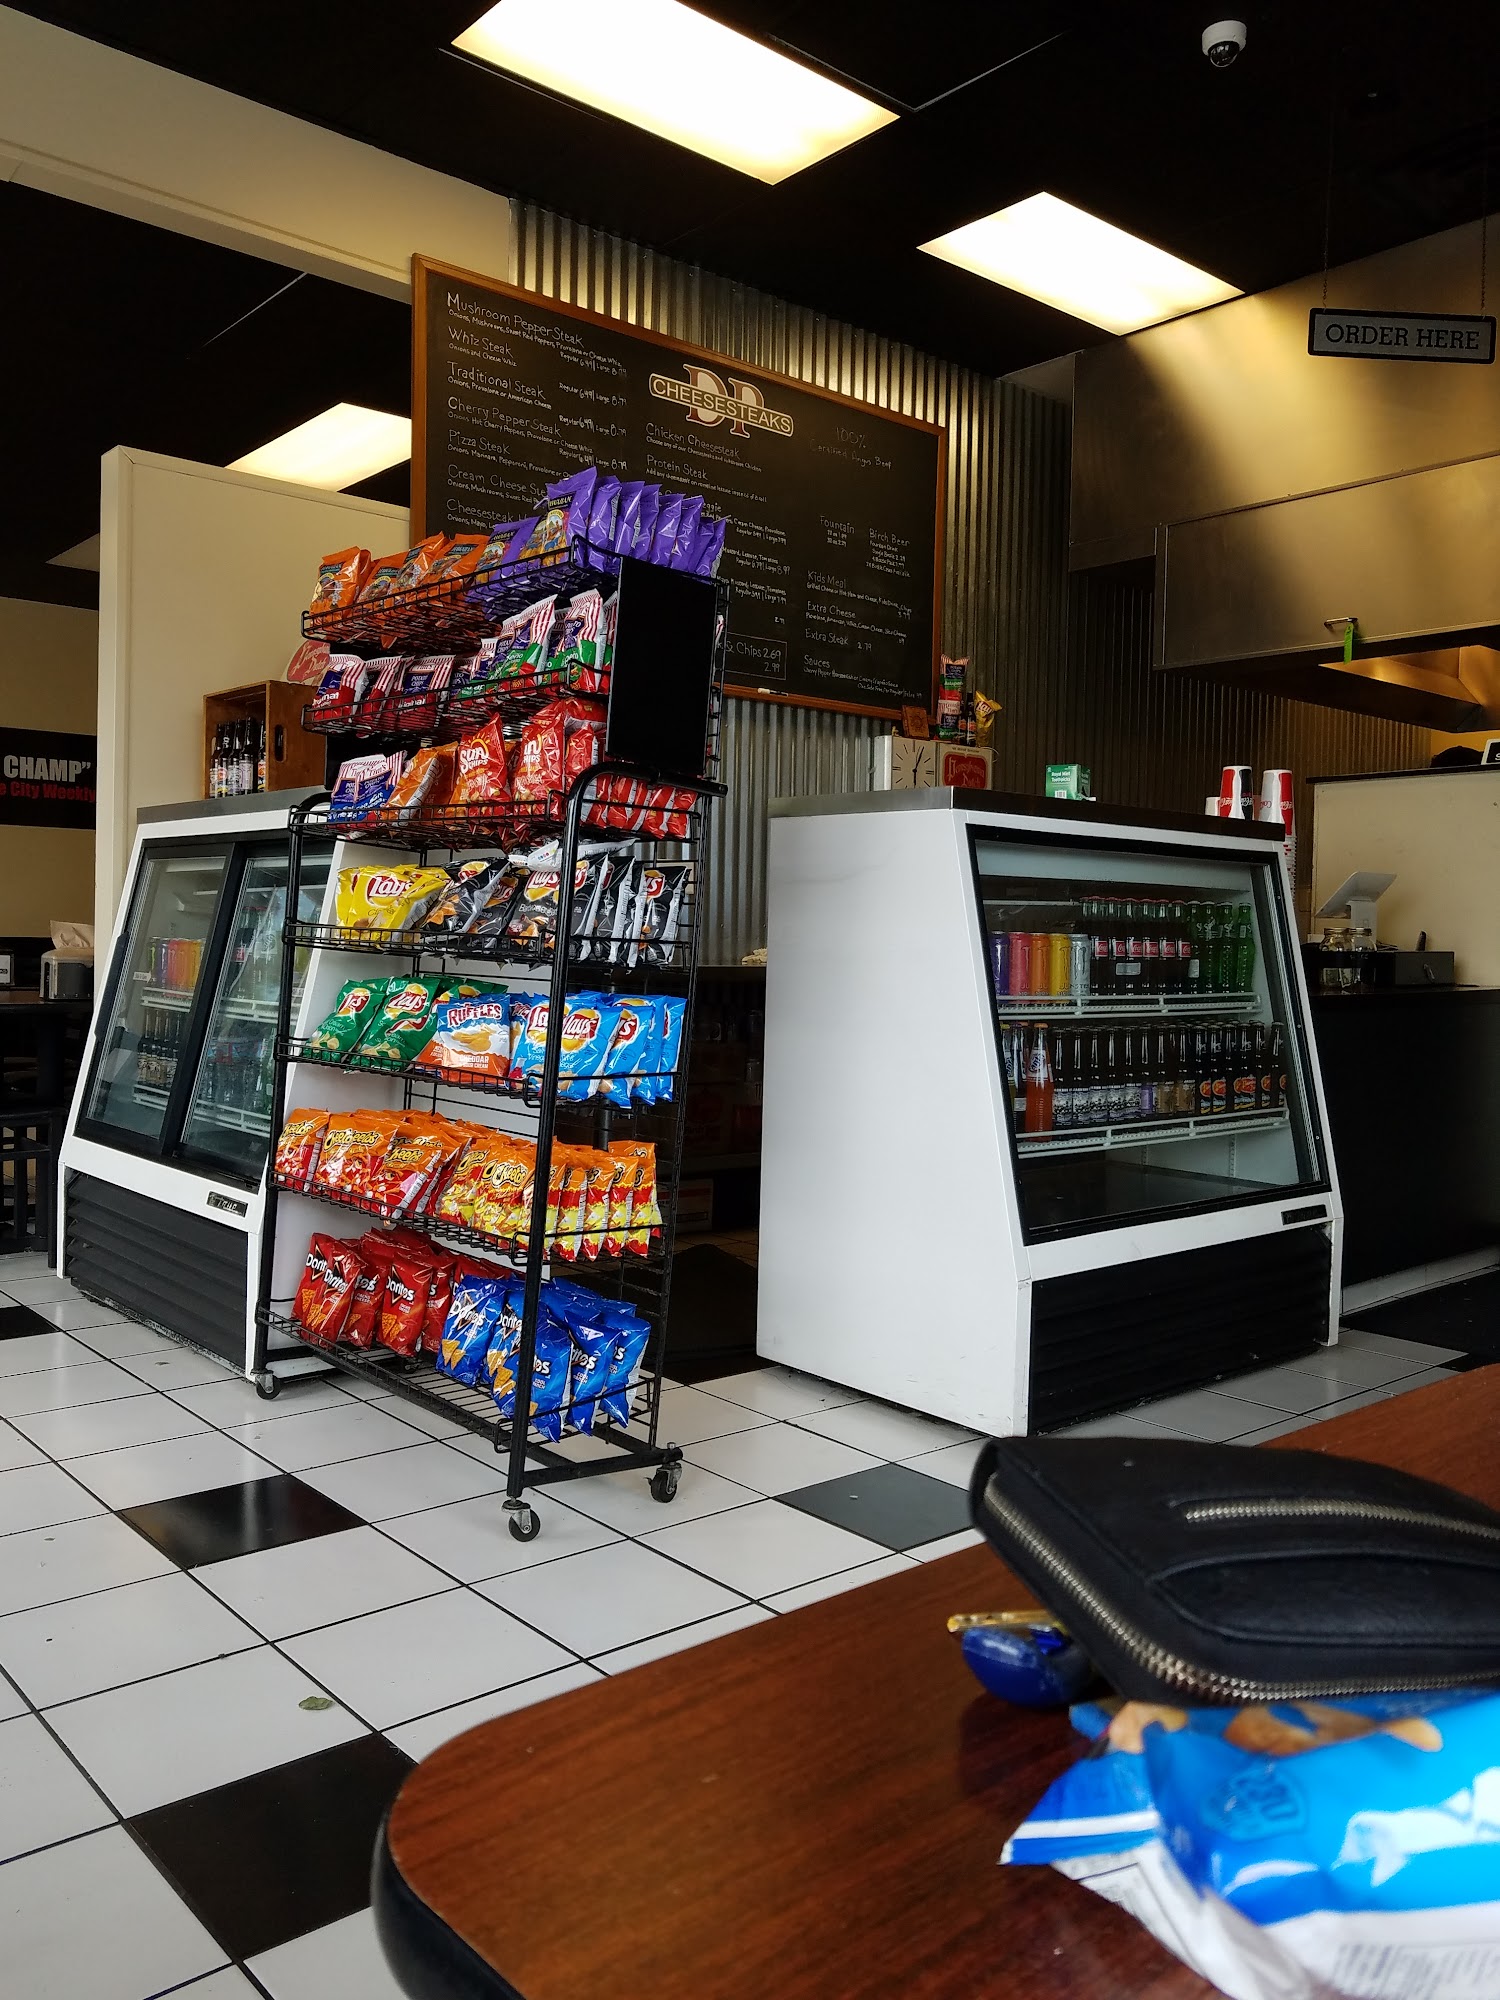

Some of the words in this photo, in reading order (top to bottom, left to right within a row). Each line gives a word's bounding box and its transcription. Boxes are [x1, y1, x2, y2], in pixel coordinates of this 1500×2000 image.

[447, 291, 511, 325] Mushroom
[513, 314, 553, 337] Pepper
[551, 326, 584, 349] Steak
[448, 326, 480, 346] Whiz
[481, 338, 514, 358] Steak
[1326, 324, 1408, 346] ORDER
[1416, 329, 1480, 350] HERE
[447, 361, 512, 391] Traditional
[514, 380, 546, 401] Steak
[447, 396, 490, 421] Cherry
[491, 407, 531, 428] Pepper
[530, 418, 562, 438] Steak
[652, 378, 791, 432] CHEESESTEAKS
[448, 430, 477, 447] Pizza
[479, 437, 511, 455] Steak
[645, 422, 686, 444] Chicken
[687, 434, 741, 461] Cheesesteak
[448, 464, 485, 484] Cream
[489, 474, 527, 493] Cheese
[646, 454, 681, 472] Protein
[683, 463, 708, 481] Steak
[446, 498, 514, 524] Cheesesteak
[702, 502, 722, 513] eggie
[819, 515, 855, 535] Fountain
[869, 527, 889, 543] Birch
[891, 533, 911, 547] Beer
[807, 570, 826, 584] Kids
[827, 574, 847, 590] Meal
[807, 600, 828, 613] Extra
[829, 604, 857, 619] Cheese
[805, 628, 827, 642] Extra
[828, 632, 849, 646] Steak
[736, 641, 762, 658] Chips
[804, 654, 831, 669] Sauces
[10, 781, 40, 799] City
[42, 782, 96, 803] Weekly
[447, 1003, 503, 1027] RUFFLES
[306, 1252, 327, 1271] Dorit
